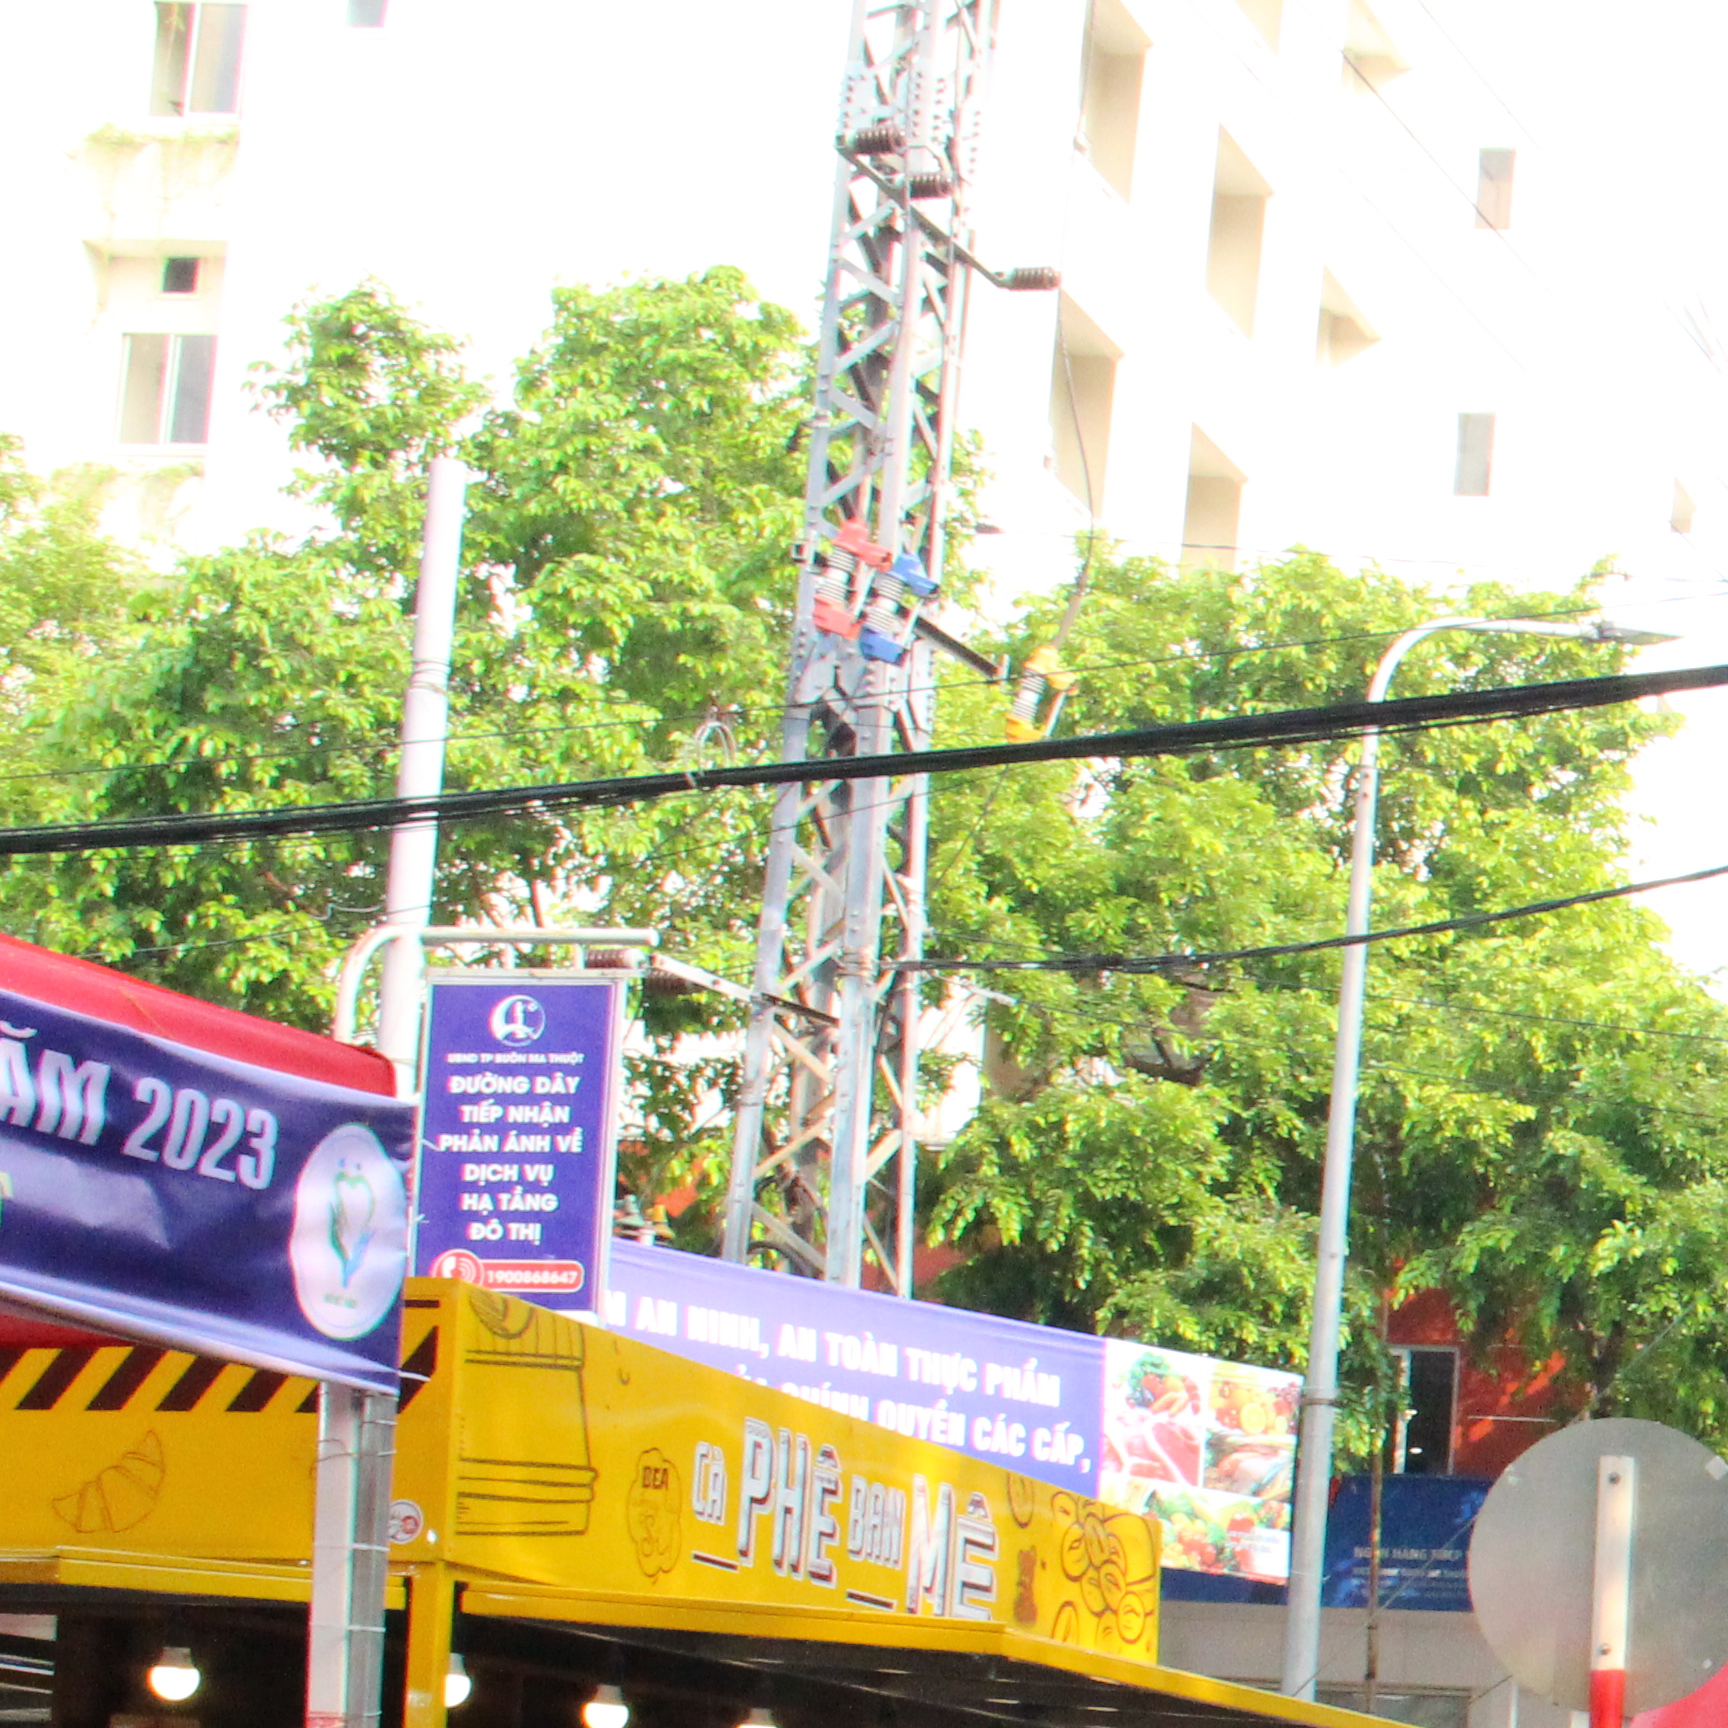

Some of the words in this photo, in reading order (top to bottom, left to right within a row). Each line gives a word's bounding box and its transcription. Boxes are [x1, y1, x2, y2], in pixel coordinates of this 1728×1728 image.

[448, 1072, 530, 1094] ĐƯỜNG
[534, 1073, 581, 1094] DÂY
[0, 1023, 112, 1146] ĂM
[121, 1076, 279, 1191] 2023
[460, 1100, 502, 1123] TIẾP
[507, 1101, 570, 1128] NHẬN
[438, 1129, 498, 1152] PHẢN
[503, 1131, 550, 1152] ÁNH
[555, 1127, 584, 1152] VỀ
[462, 1164, 519, 1186] DỊCH
[525, 1164, 555, 1186] VỤ
[460, 1194, 493, 1215] HẠ
[497, 1187, 559, 1211] TẦNG
[467, 1219, 503, 1241] ĐÔ
[507, 1223, 542, 1245] THỊ
[635, 1297, 677, 1336] AN
[686, 1305, 769, 1359] NINH,
[777, 1324, 817, 1363] AN
[822, 1331, 898, 1377] TOÀN
[903, 1348, 977, 1394] THỰC
[983, 1357, 1060, 1408] PHẨM
[972, 1414, 1026, 1457] CÁC
[737, 1416, 842, 1590] PHÊ
[846, 1474, 906, 1570] BAN
[906, 1473, 1000, 1621] MÊ
